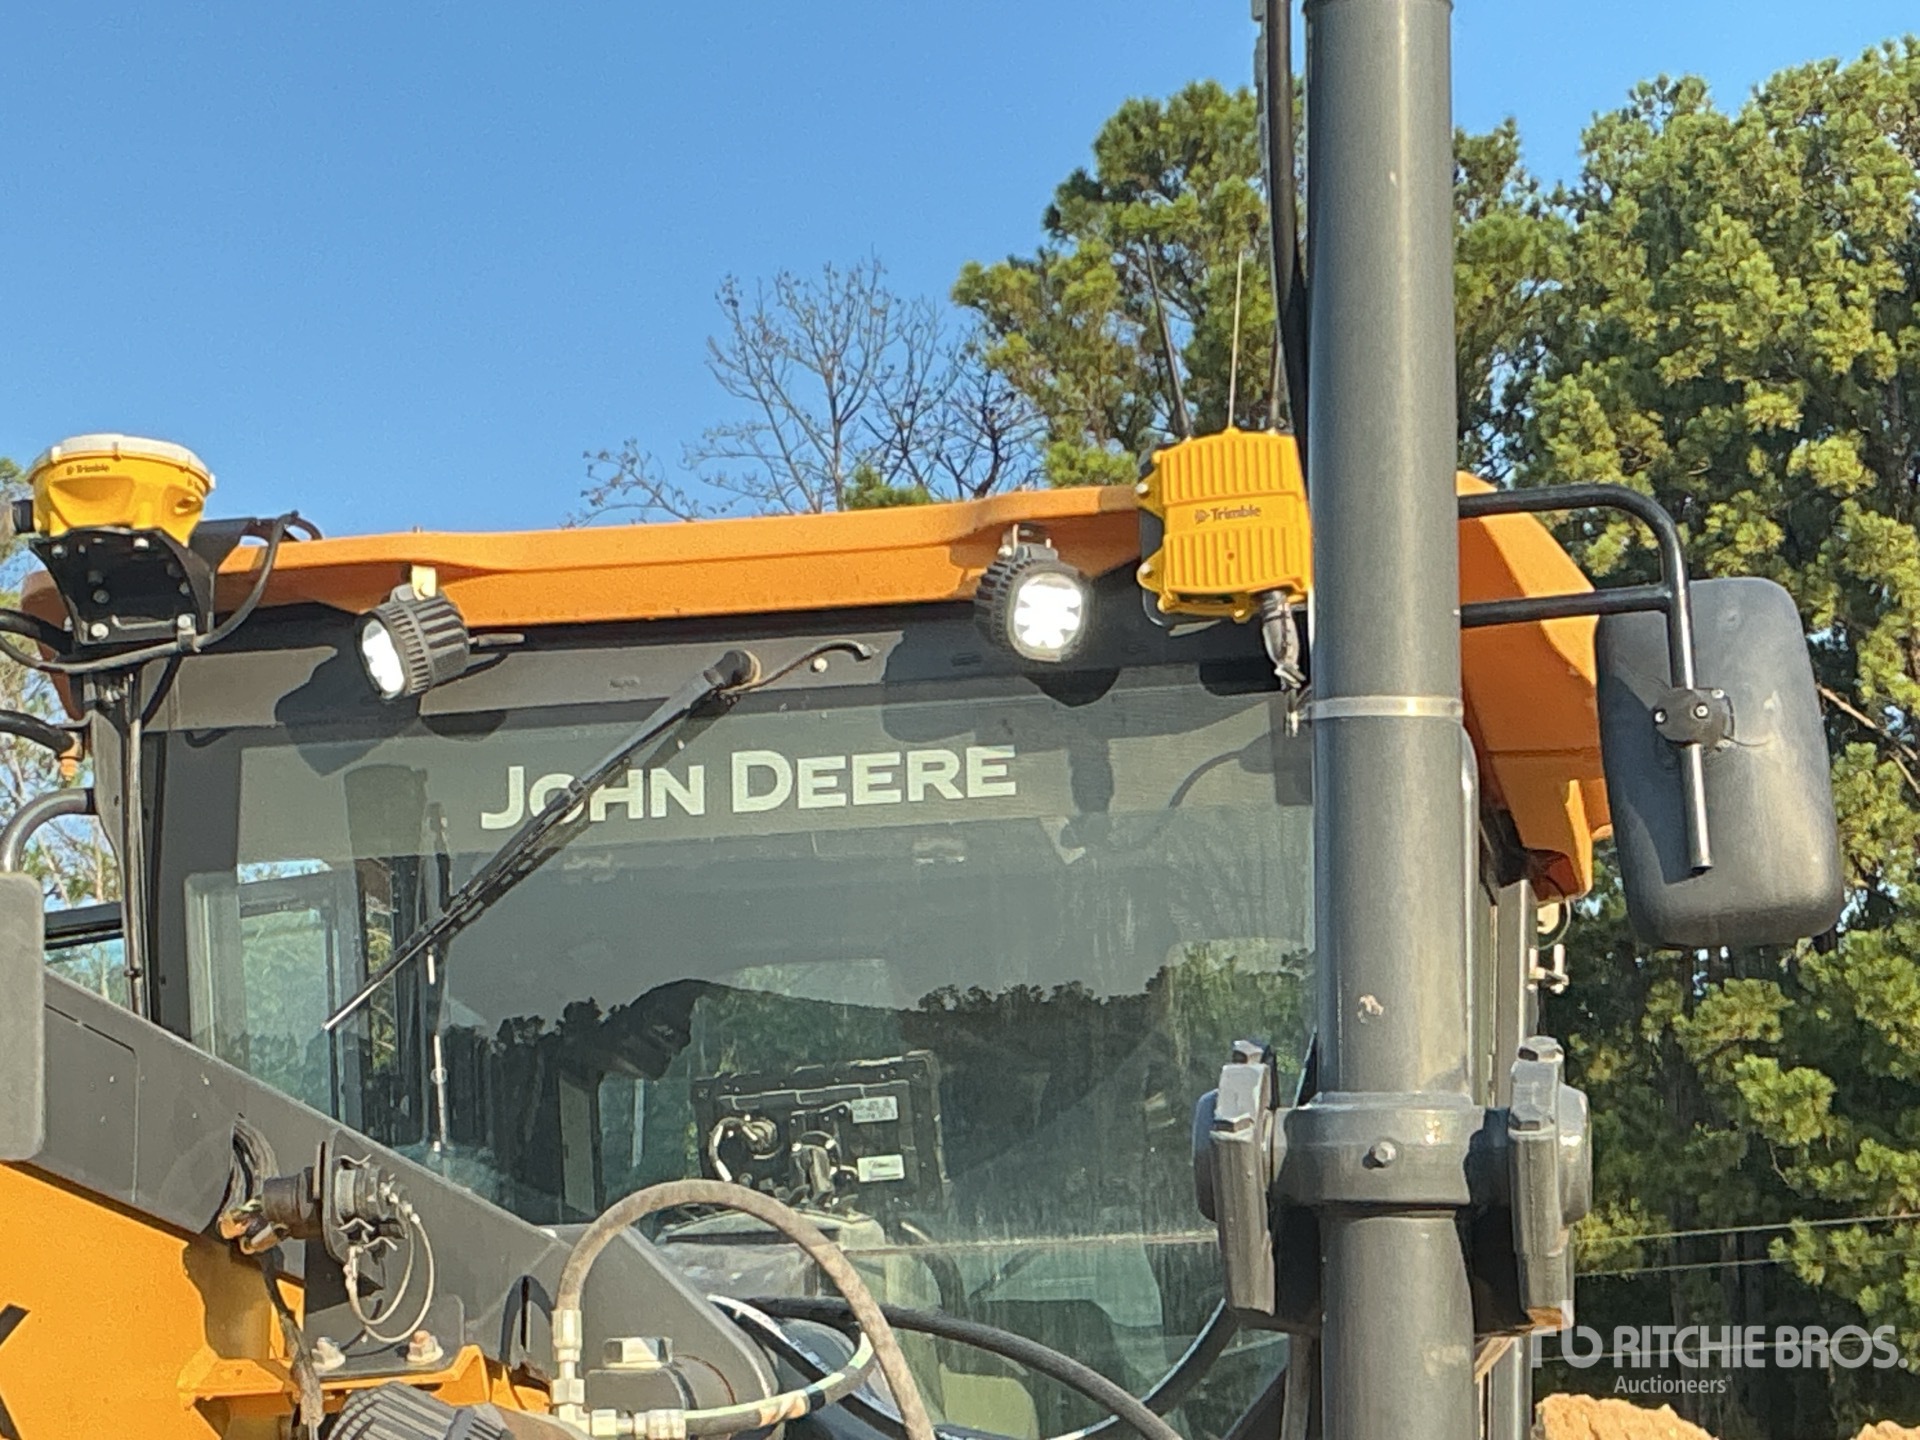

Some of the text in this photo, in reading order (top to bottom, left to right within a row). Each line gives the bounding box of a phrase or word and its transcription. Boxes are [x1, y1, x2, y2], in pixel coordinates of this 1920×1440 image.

[1210, 504, 1261, 521] Trimble
[480, 744, 1017, 830] JOHN DEERE
